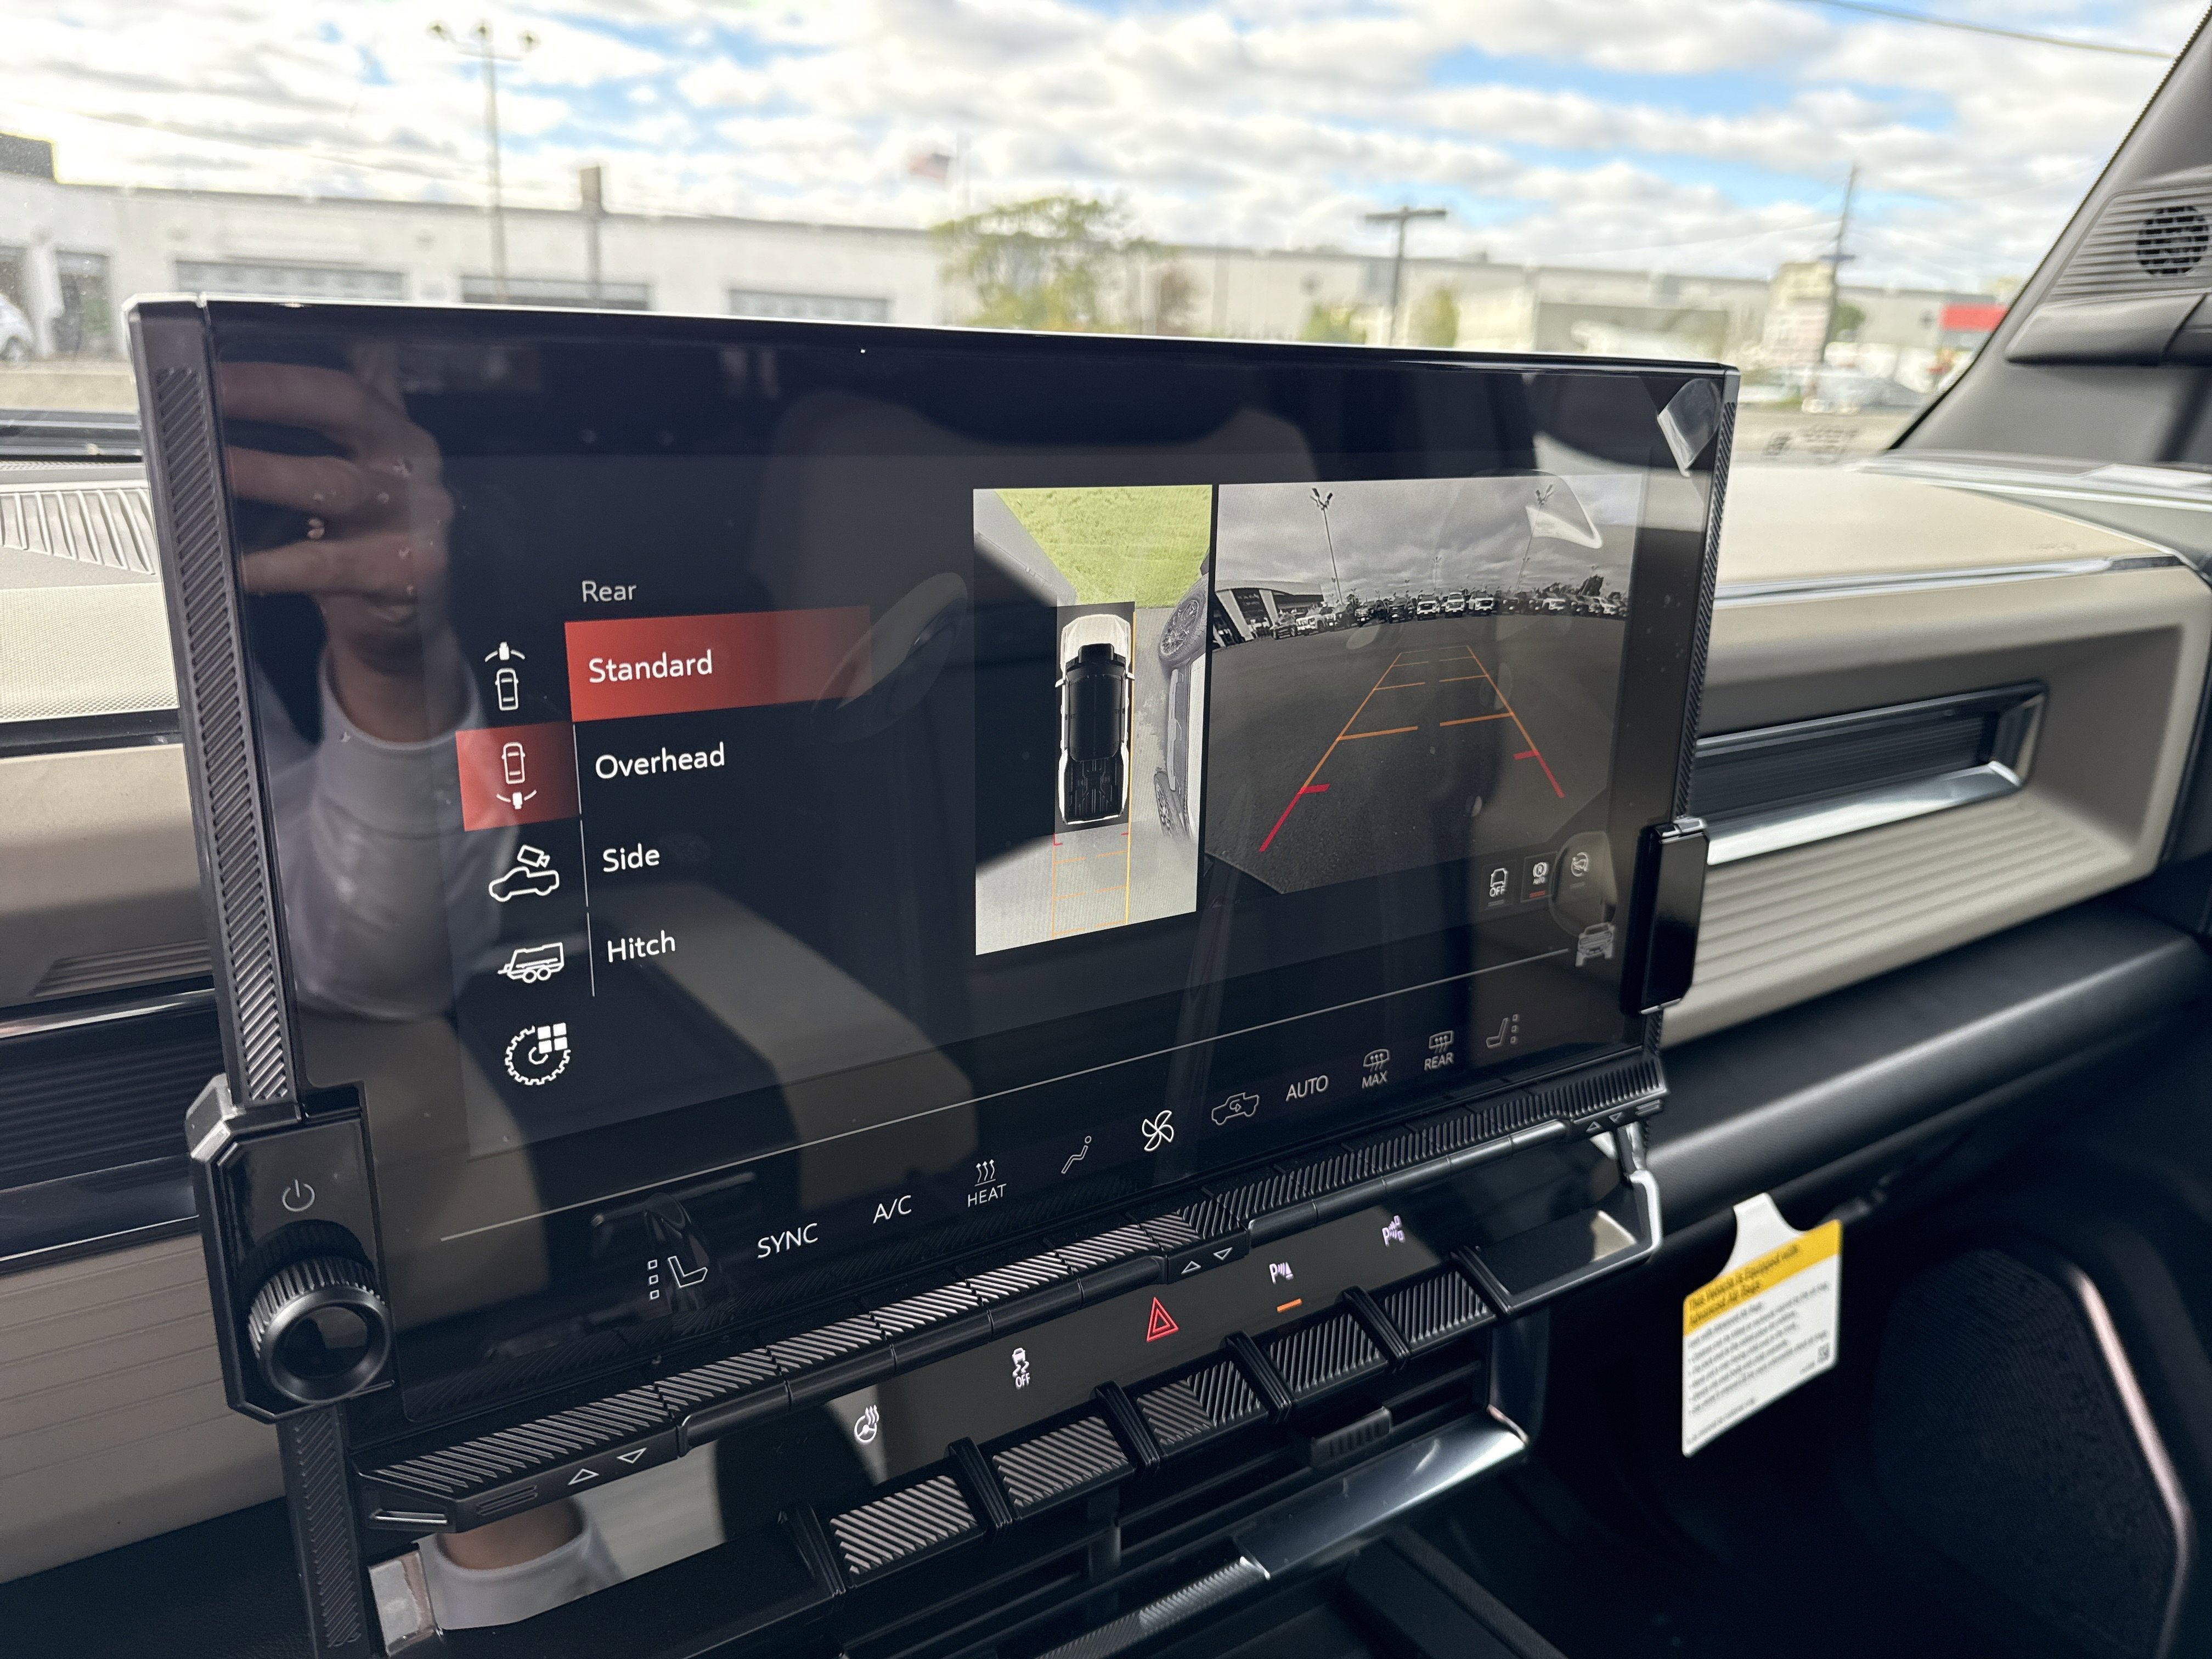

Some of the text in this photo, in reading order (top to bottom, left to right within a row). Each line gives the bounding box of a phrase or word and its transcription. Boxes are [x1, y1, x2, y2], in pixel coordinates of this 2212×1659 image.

[582, 580, 637, 602] Rear
[589, 648, 713, 684] Standard
[595, 741, 725, 779] Overhead
[603, 843, 660, 872] Side
[1489, 885, 1505, 897] OFF
[607, 929, 676, 963] Hitch
[1424, 1052, 1454, 1070] REAR
[1286, 1075, 1329, 1102] AUTO
[1362, 1070, 1388, 1089] MAX
[967, 1183, 1007, 1207] HEAT
[873, 1195, 912, 1224] A/C
[757, 1223, 818, 1259] SYNC
[1015, 1373, 1030, 1389] OFF
